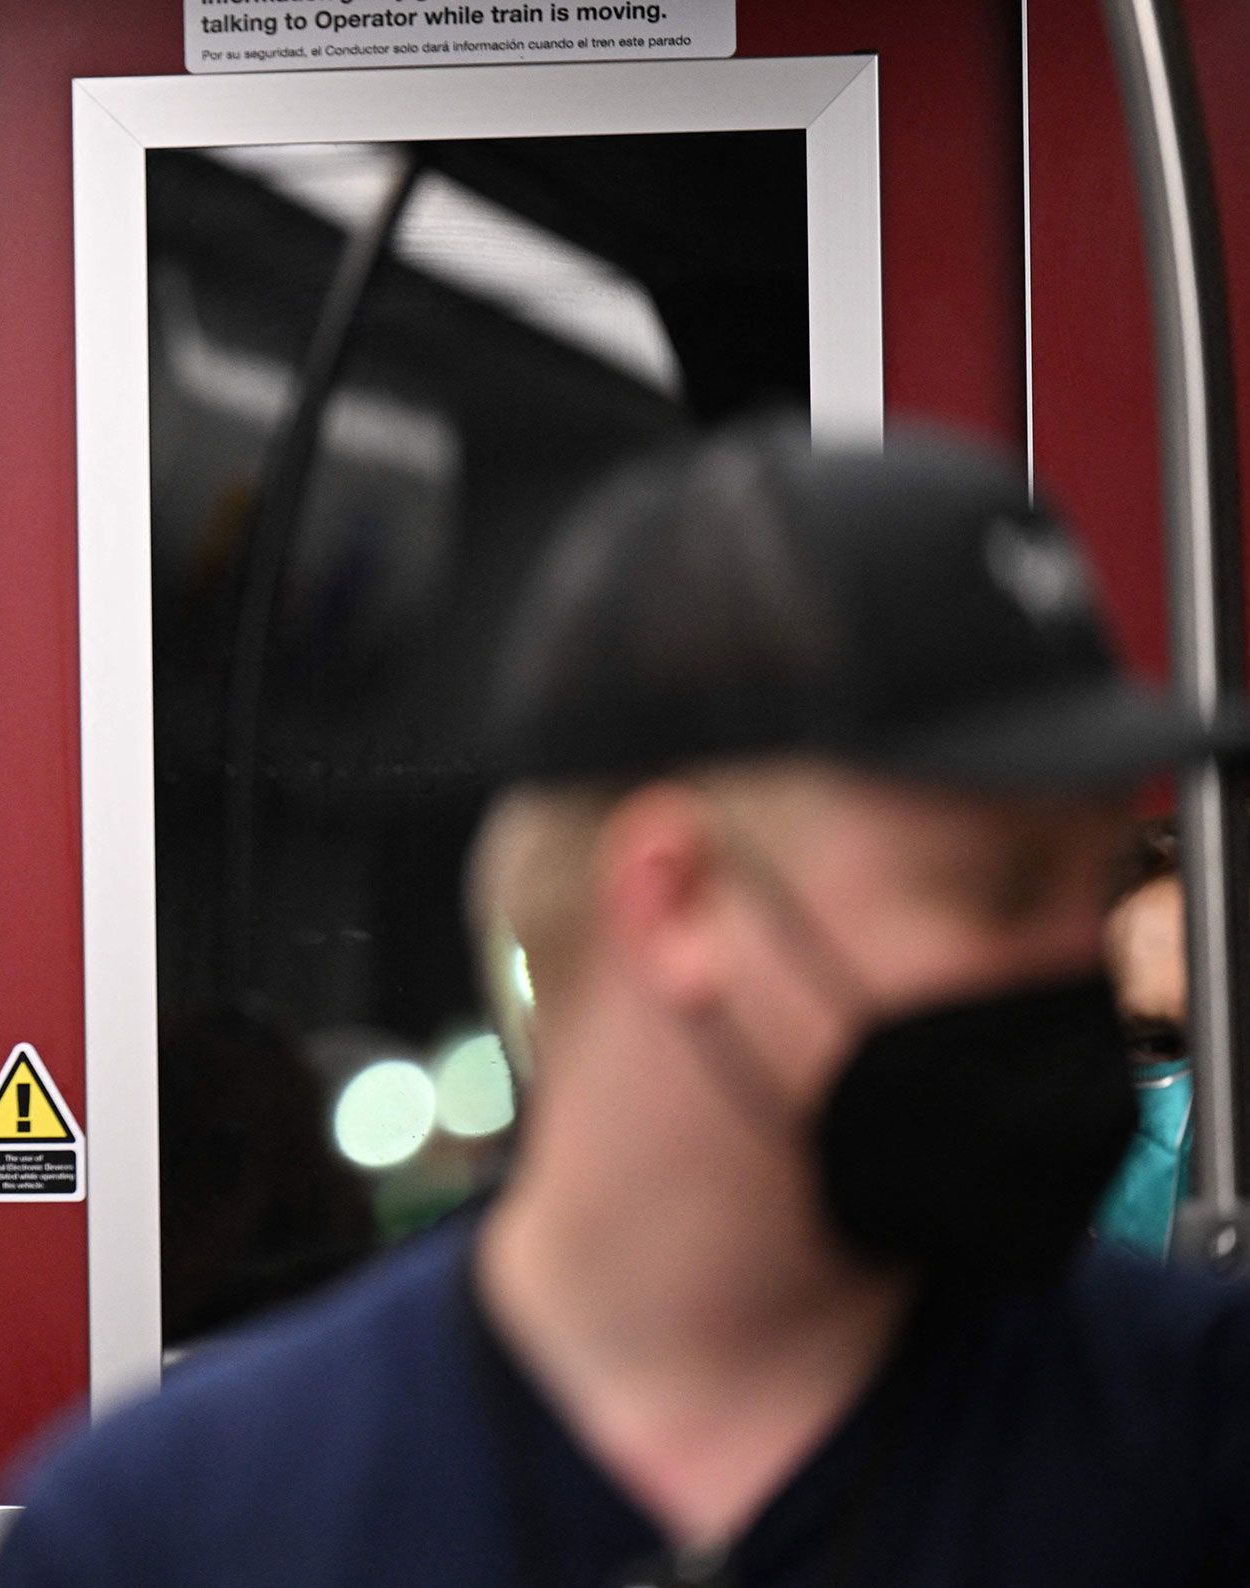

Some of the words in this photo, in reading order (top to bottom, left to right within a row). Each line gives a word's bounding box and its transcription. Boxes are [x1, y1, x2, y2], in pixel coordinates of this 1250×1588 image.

[201, 14, 277, 35] talking
[285, 13, 307, 30] to
[315, 9, 417, 32] Operator
[424, 5, 484, 25] while
[492, 4, 543, 23] train
[550, 3, 569, 22] is
[577, 1, 667, 23] moving.
[202, 50, 223, 61] Por
[226, 51, 240, 60] su
[244, 48, 307, 61] seguridad,
[311, 46, 322, 57] el
[325, 43, 389, 56] Conductor
[393, 43, 419, 54] solo
[422, 41, 449, 54] dará
[452, 39, 524, 52] información
[528, 38, 573, 50] cuando
[577, 37, 588, 49] el
[592, 37, 615, 48] tren
[619, 36, 644, 47] este
[648, 35, 691, 48] parado
